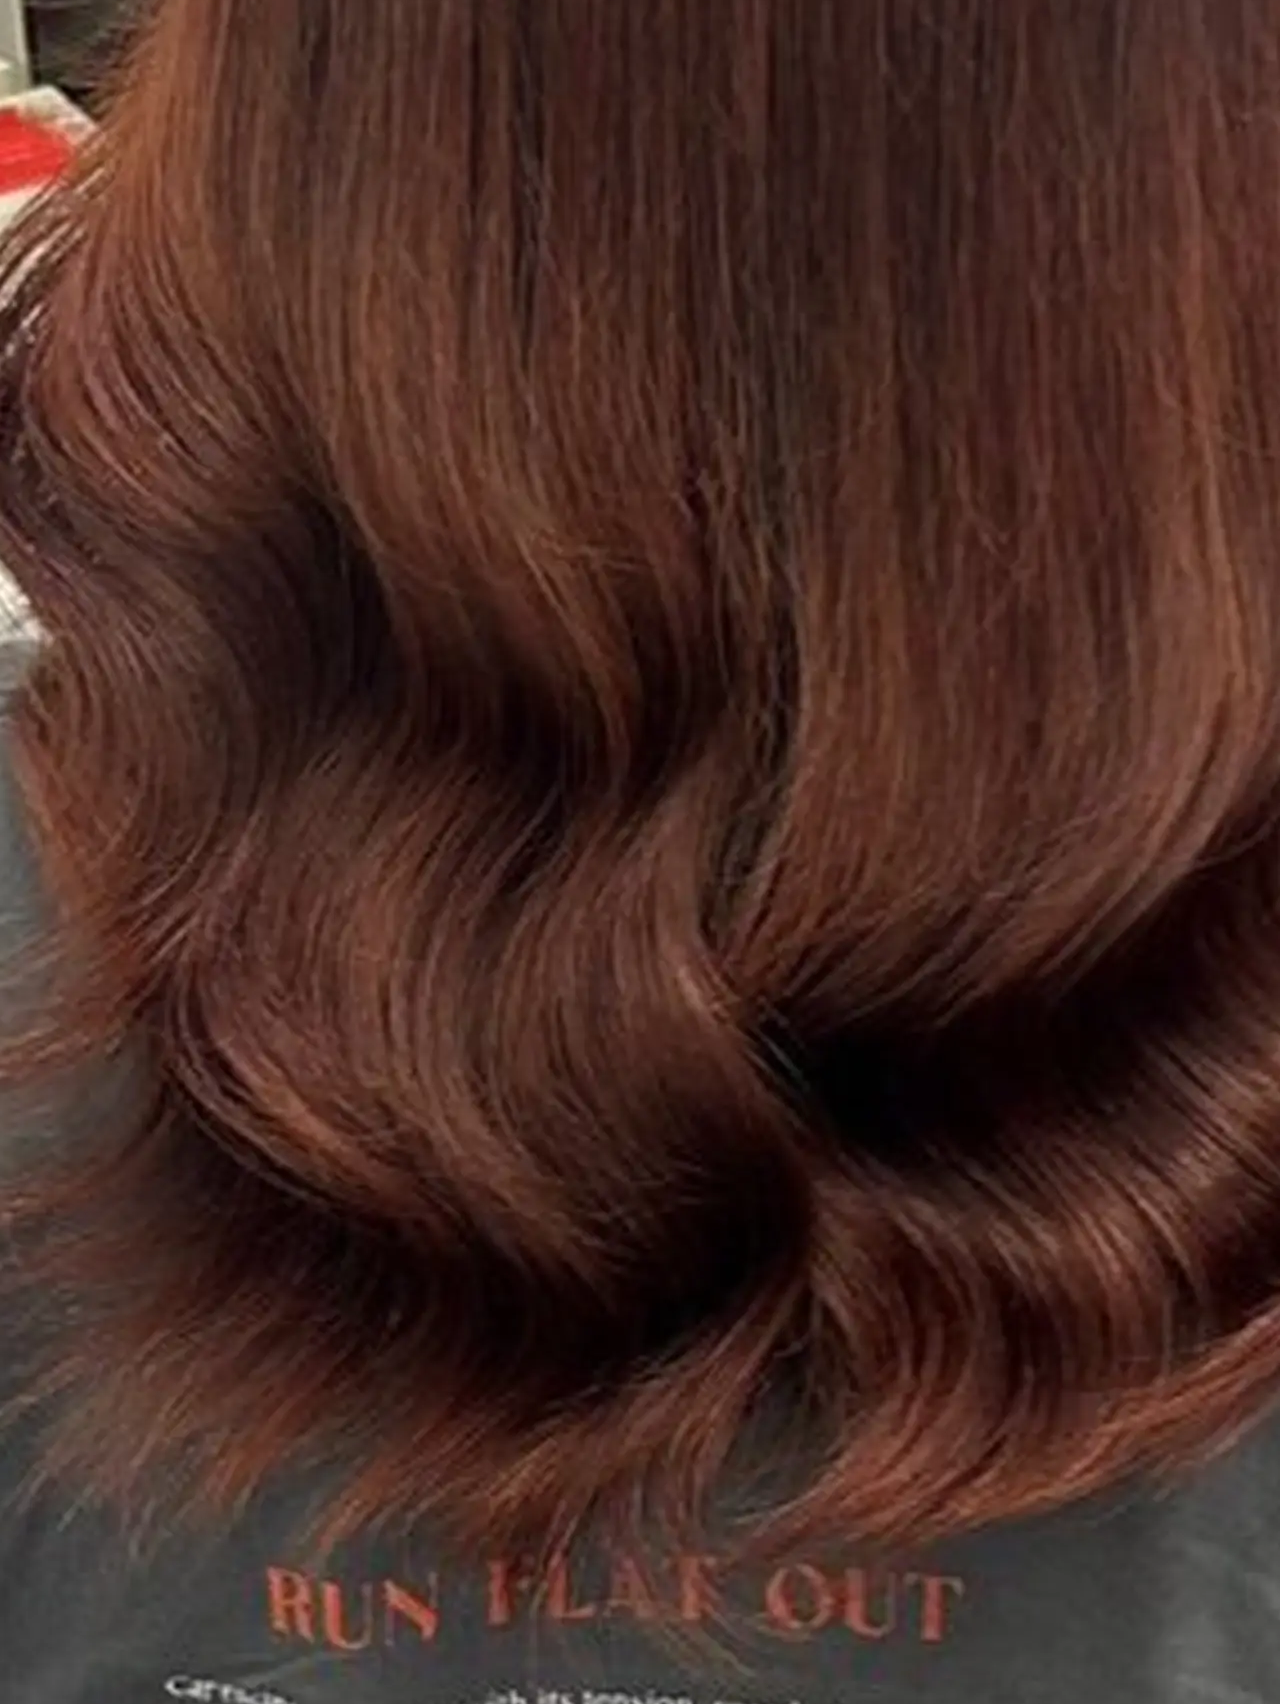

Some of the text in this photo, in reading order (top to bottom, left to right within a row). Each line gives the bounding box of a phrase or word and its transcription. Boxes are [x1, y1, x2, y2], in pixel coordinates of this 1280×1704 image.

[265, 1551, 966, 1652] RUN FLAT OUT
